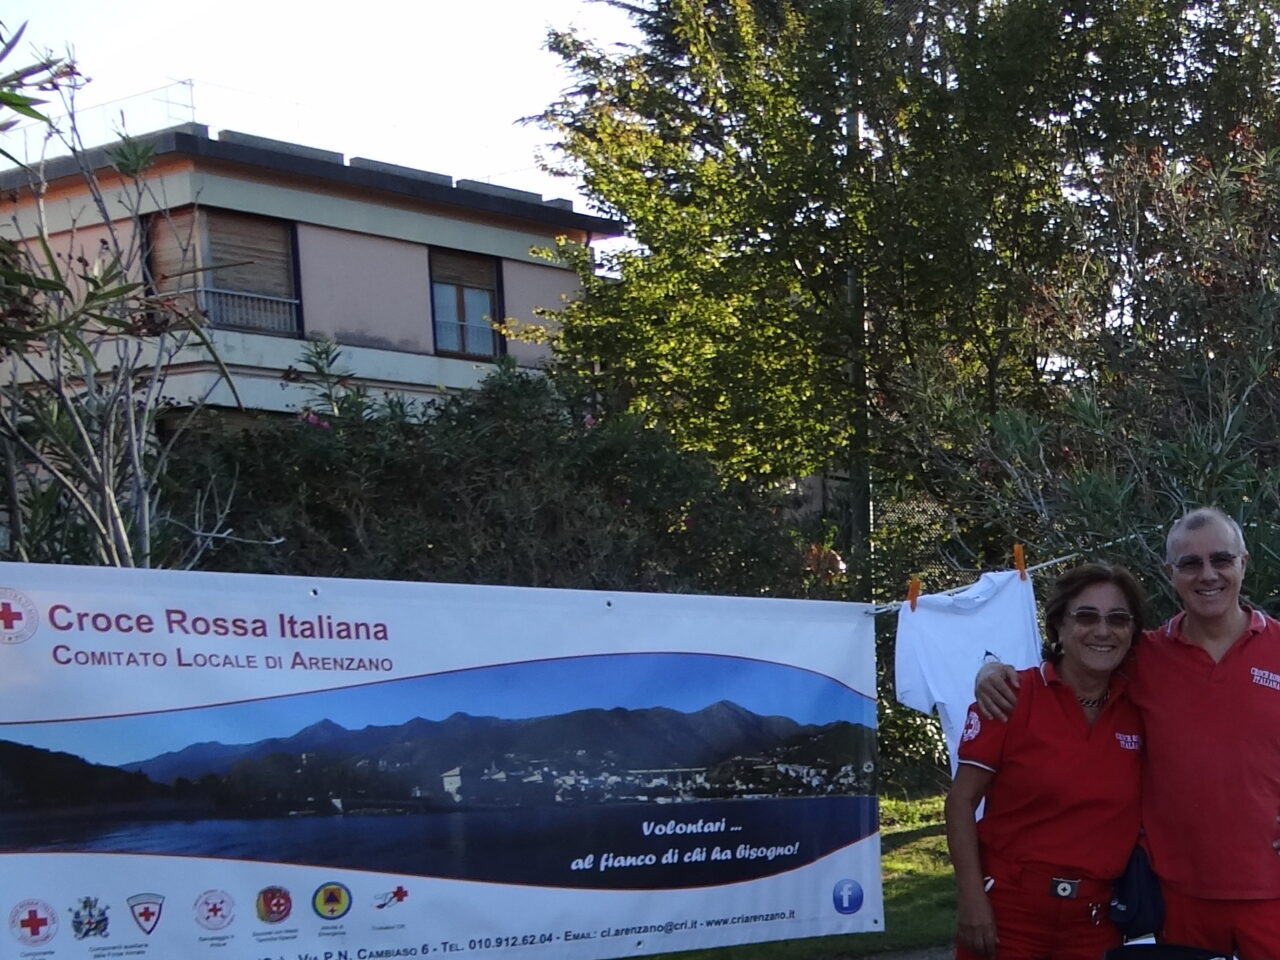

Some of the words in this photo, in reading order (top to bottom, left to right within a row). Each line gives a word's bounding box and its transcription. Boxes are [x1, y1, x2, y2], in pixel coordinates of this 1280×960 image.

[48, 603, 154, 634] Croce
[165, 608, 268, 638] Rossa
[279, 613, 389, 641] Italiana
[52, 644, 167, 667] COMITATO
[176, 648, 258, 669] LOCALE
[290, 652, 393, 672] ARENZANO
[642, 818, 726, 836] Volontari
[571, 854, 594, 870] al
[600, 852, 656, 872] fianco
[661, 848, 679, 864] di
[683, 847, 706, 863] chi
[711, 846, 732, 861] ha
[736, 841, 800, 861] bisogno!
[357, 946, 418, 960] CAMBIASO
[421, 943, 429, 955] 6
[468, 932, 553, 950] 010.912.62.04
[705, 910, 795, 927] www.criarenzano.it
